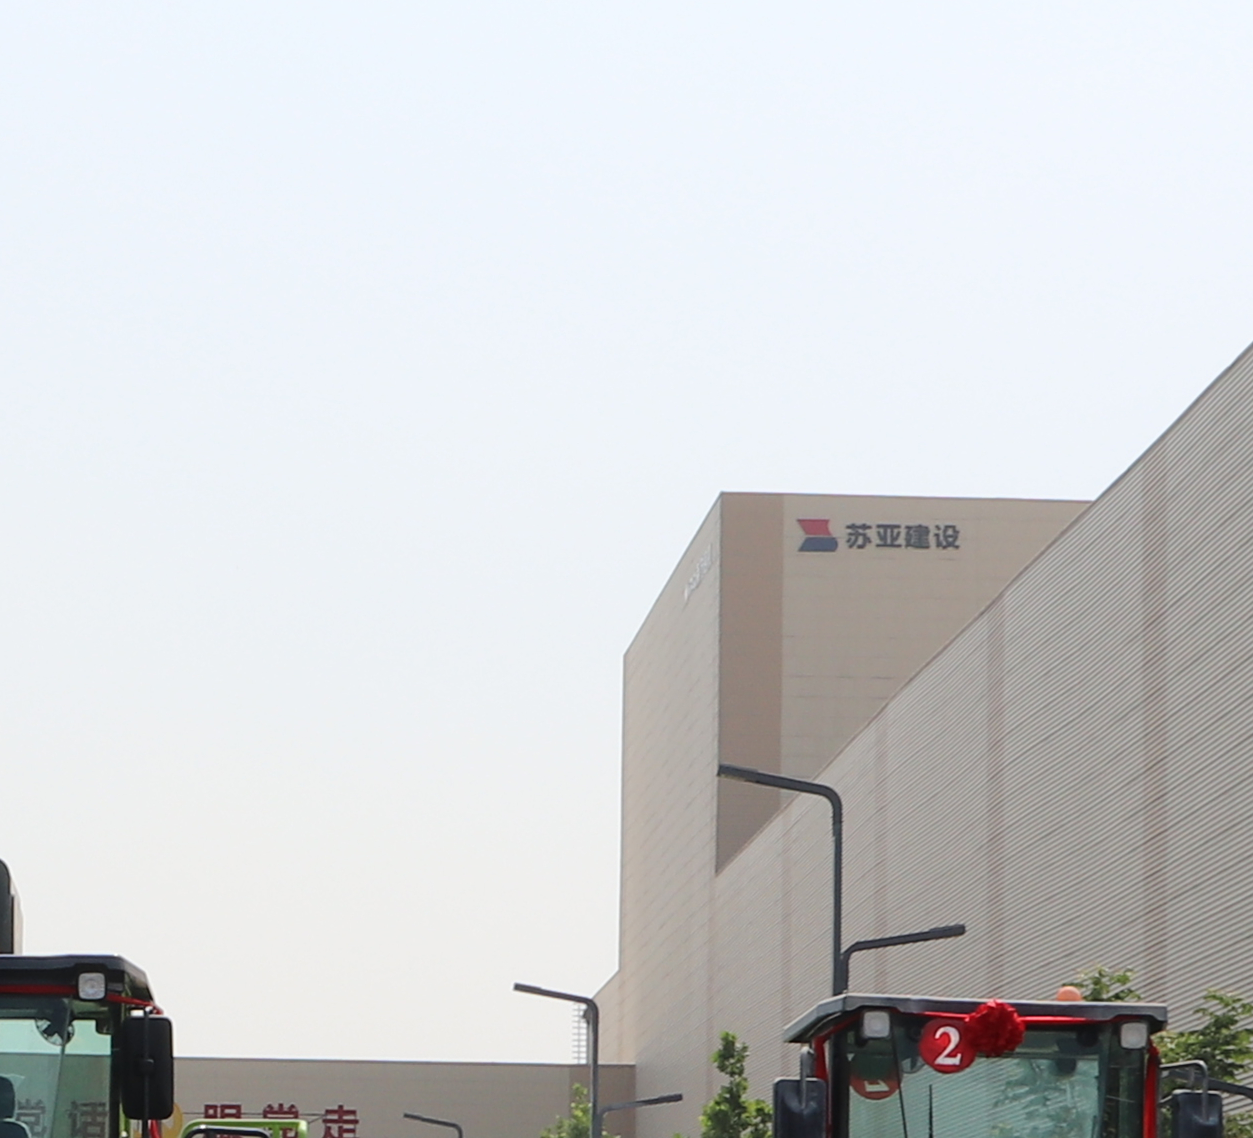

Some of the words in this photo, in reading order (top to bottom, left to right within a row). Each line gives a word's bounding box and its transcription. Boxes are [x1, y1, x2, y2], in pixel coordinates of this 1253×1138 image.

[845, 523, 960, 550] 苏亚建设
[934, 1026, 962, 1066] 2
